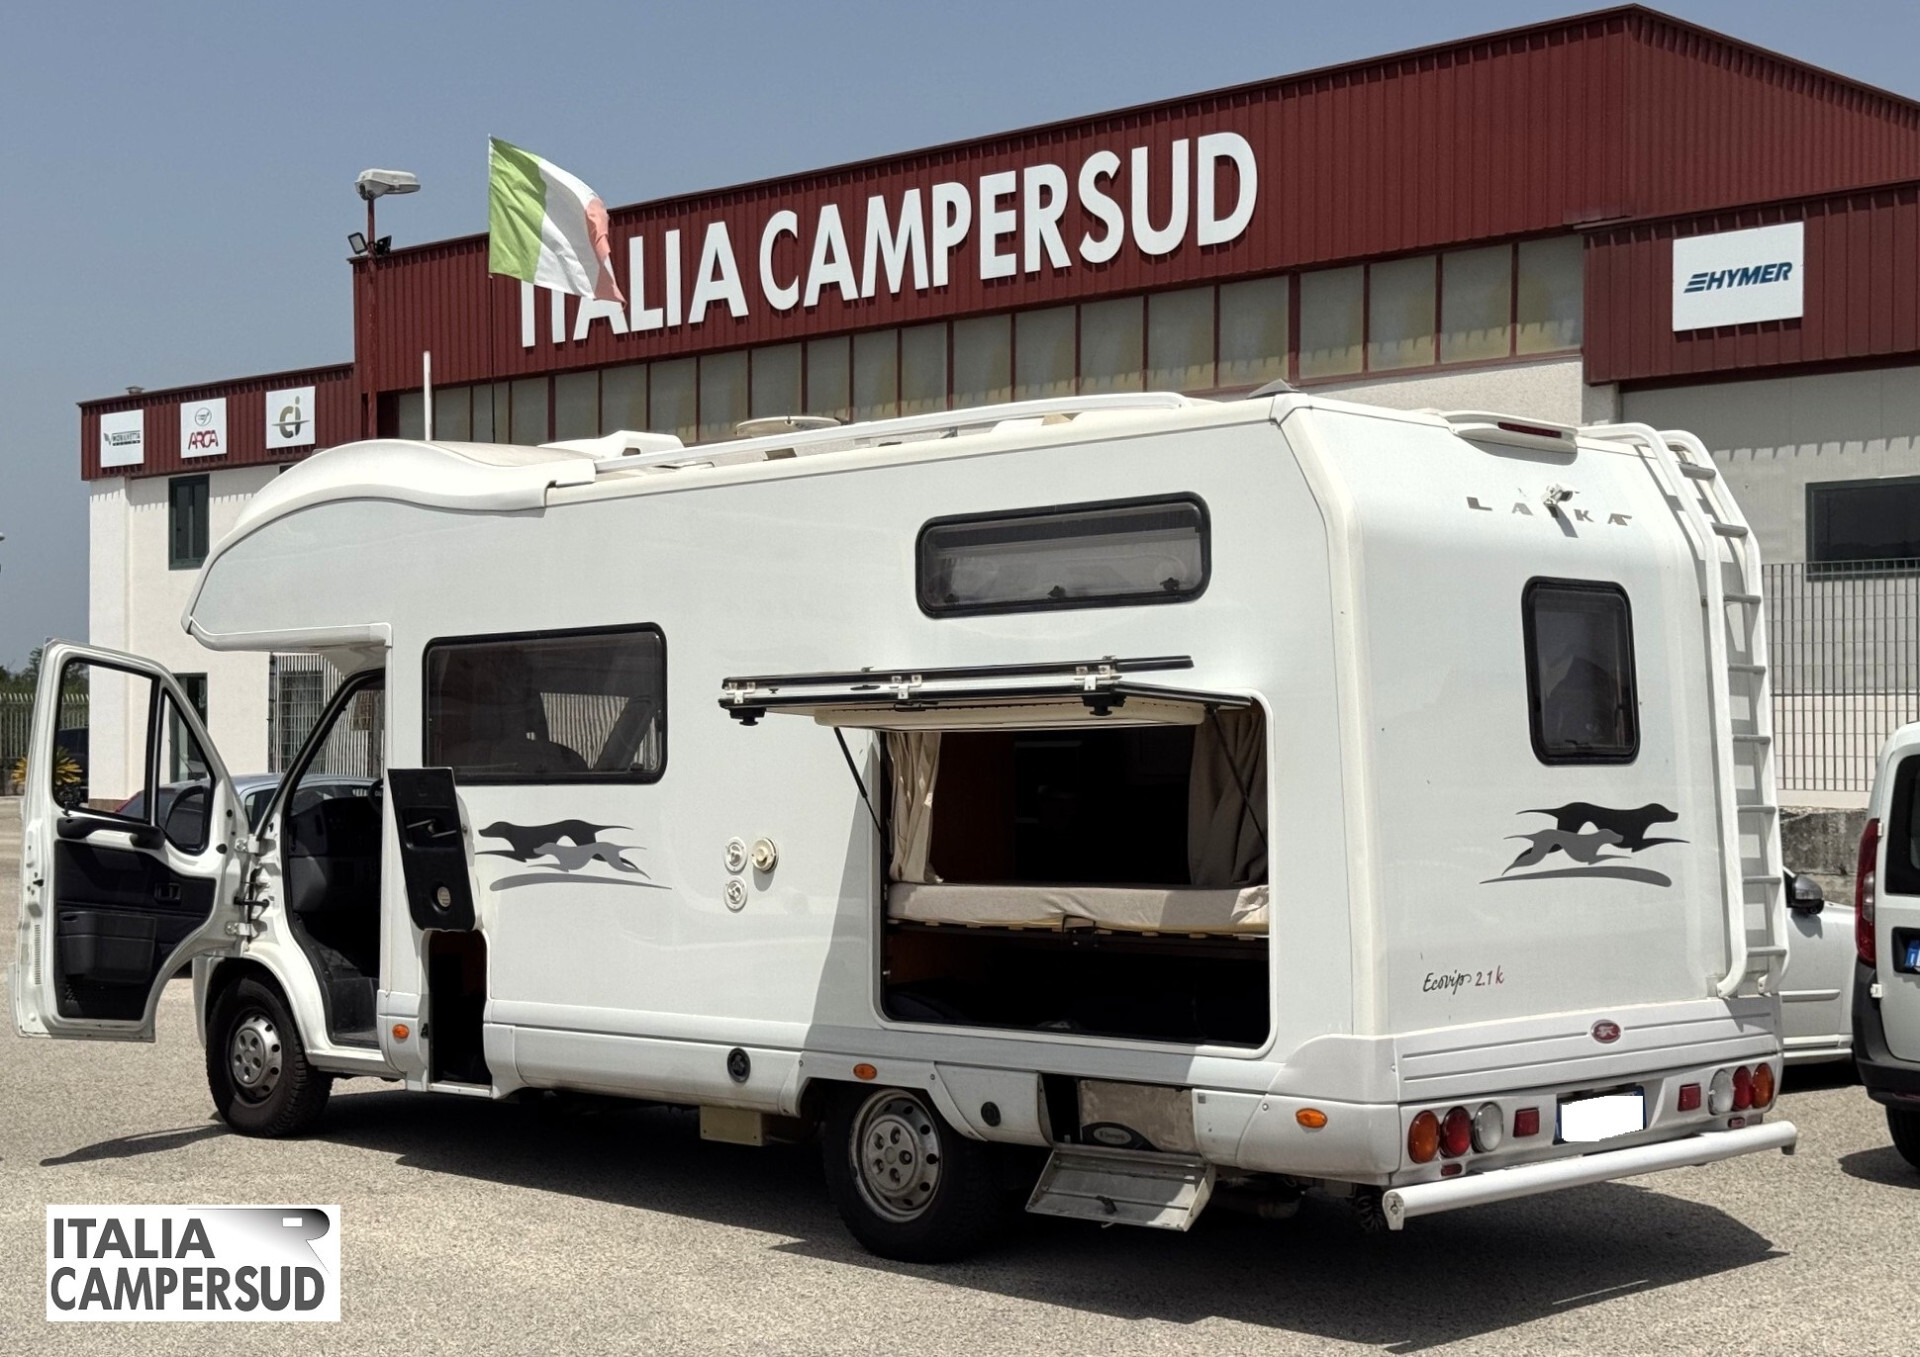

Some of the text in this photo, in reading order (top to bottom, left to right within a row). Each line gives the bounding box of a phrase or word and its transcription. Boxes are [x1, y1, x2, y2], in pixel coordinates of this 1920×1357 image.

[759, 132, 1258, 311] CAMPERSUD
[1706, 262, 1793, 291] HYMER
[187, 429, 219, 450] ARCA
